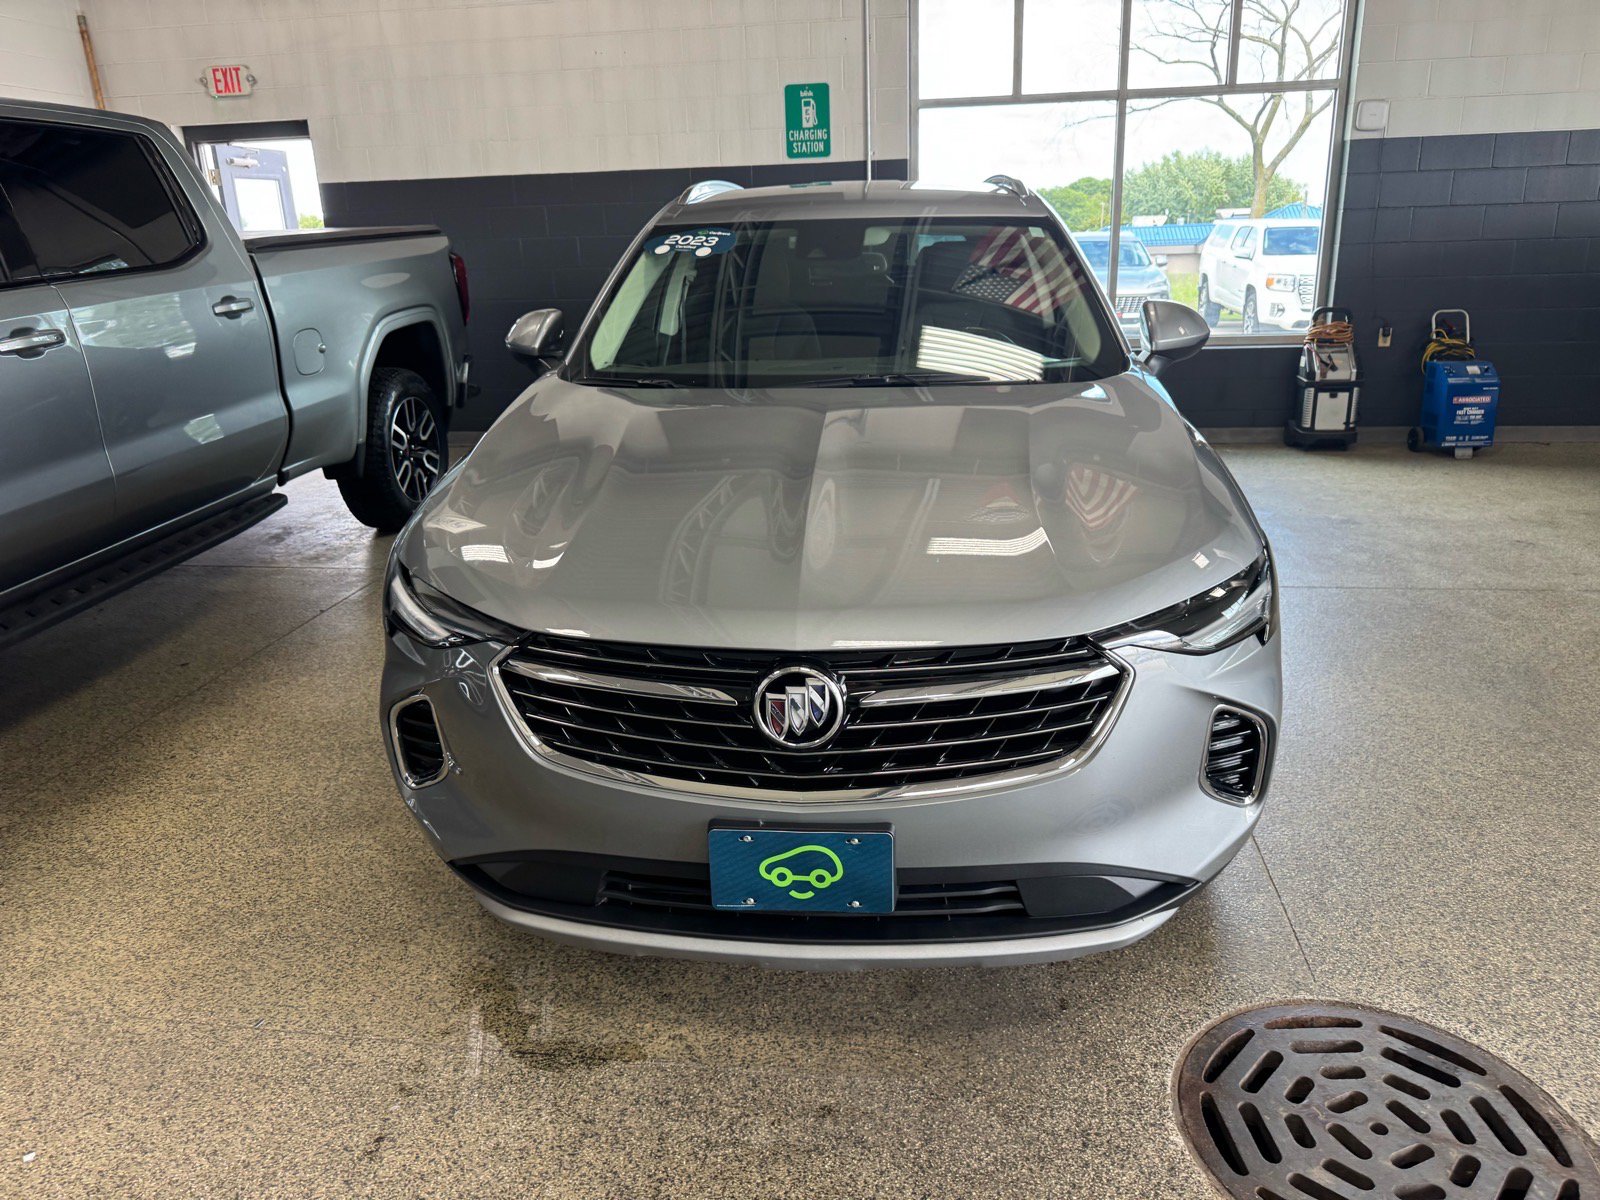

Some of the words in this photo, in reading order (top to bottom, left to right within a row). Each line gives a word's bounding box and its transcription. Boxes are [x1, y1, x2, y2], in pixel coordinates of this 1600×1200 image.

[212, 67, 242, 94] EXIT
[788, 129, 828, 142] CHARGING
[792, 141, 825, 154] STATION
[664, 234, 719, 247] 2023
